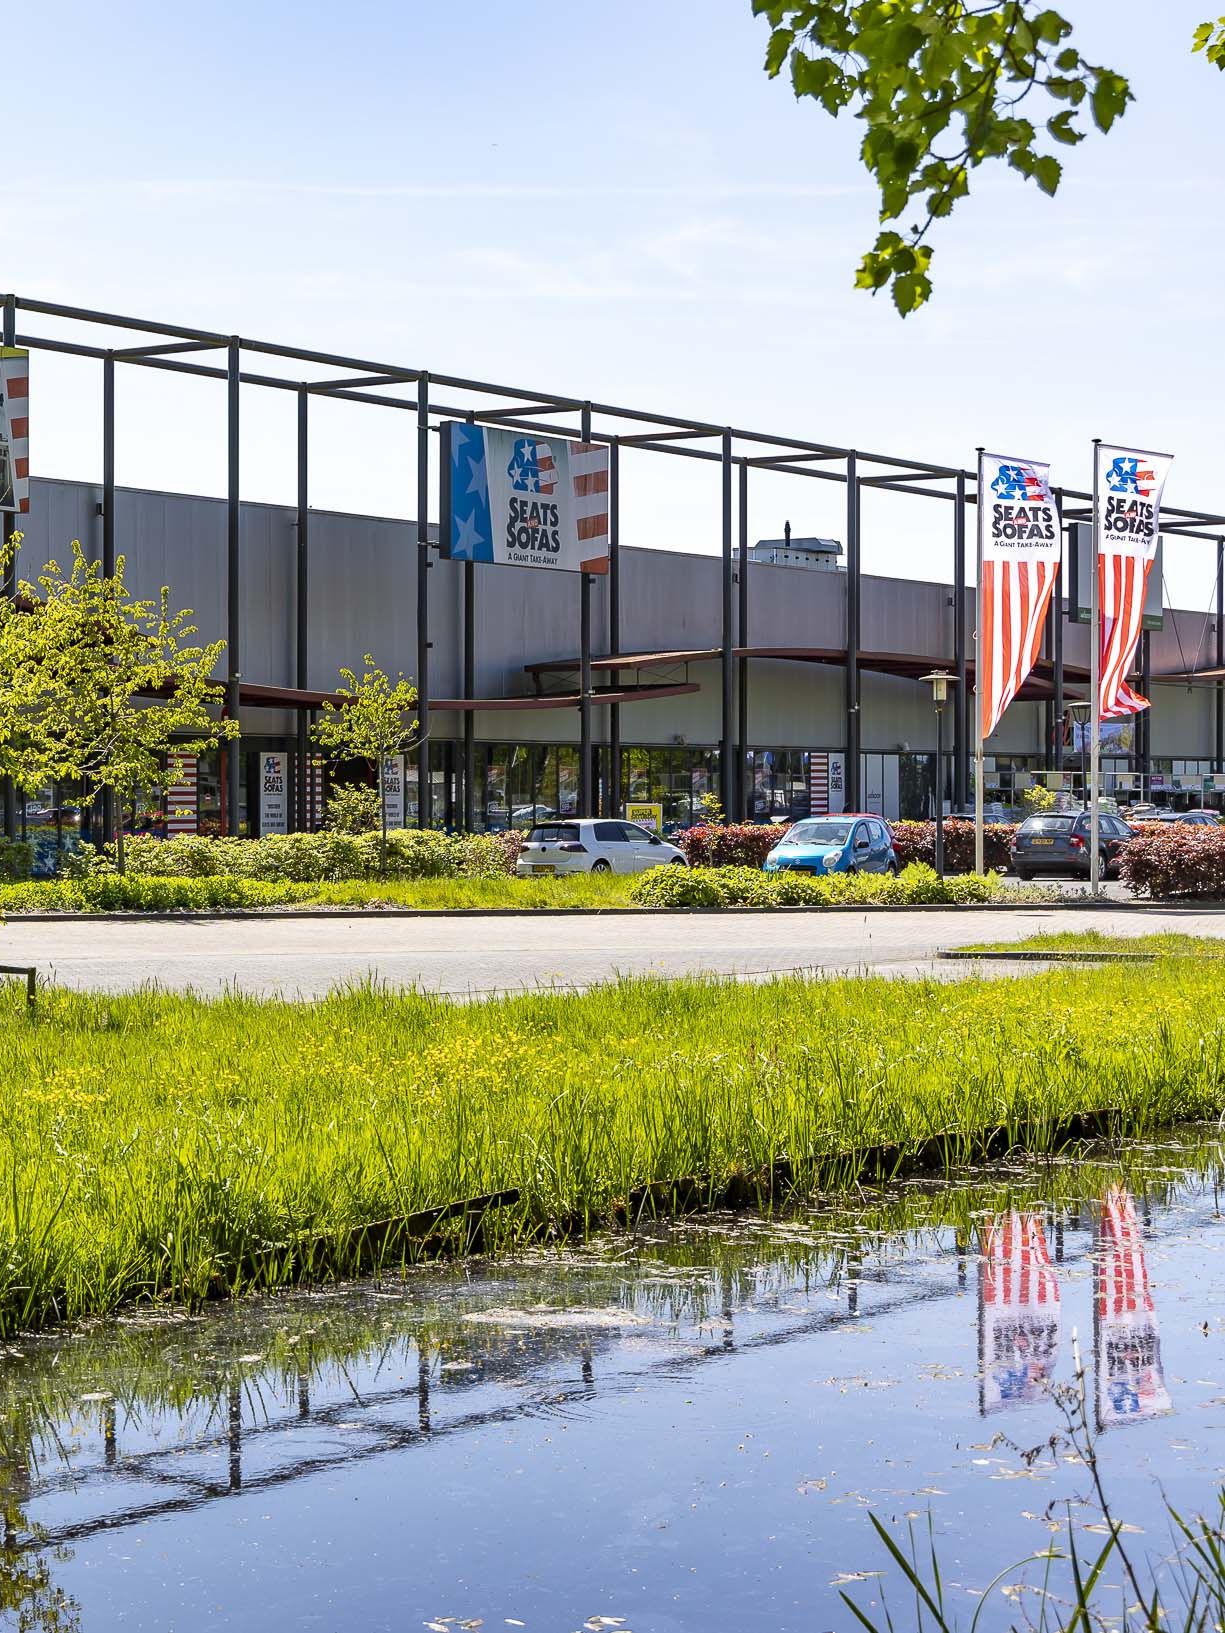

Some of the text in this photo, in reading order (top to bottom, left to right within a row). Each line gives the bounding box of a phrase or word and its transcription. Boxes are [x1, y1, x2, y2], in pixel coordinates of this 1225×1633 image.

[509, 497, 558, 527] SEATS
[993, 503, 1052, 522] SEATS
[1107, 496, 1154, 520] SEATS
[992, 520, 1055, 540] SOFAS
[1104, 514, 1154, 537] SOFAS
[507, 522, 560, 553] SOFAS
[508, 552, 512, 561] A
[264, 783, 284, 792] SOFAS
[265, 776, 283, 784] SEATS
